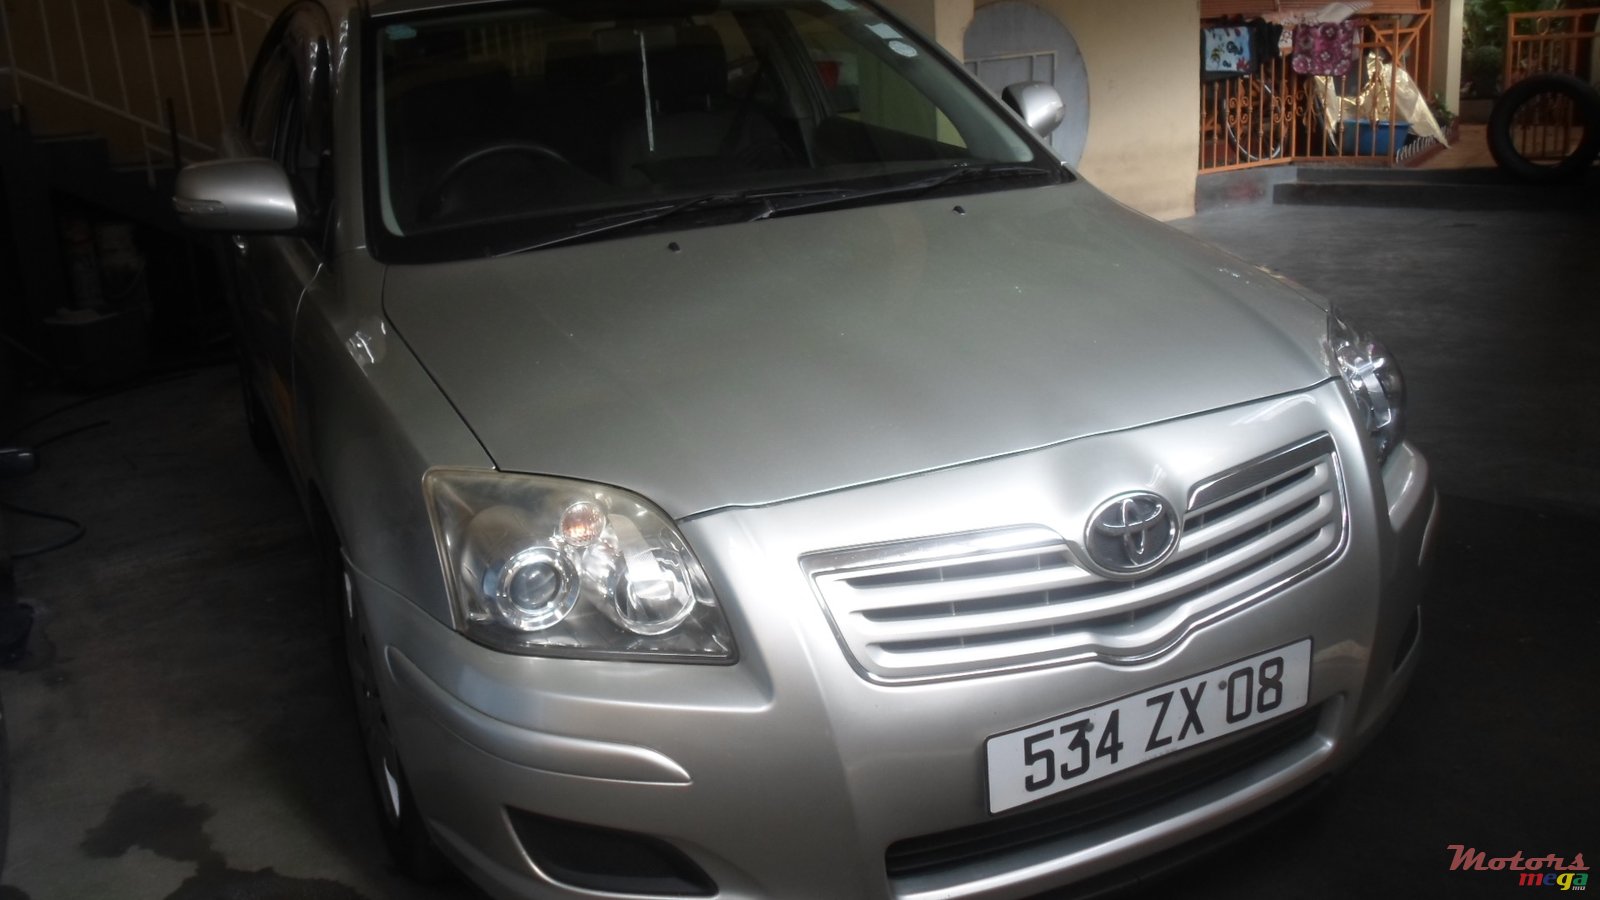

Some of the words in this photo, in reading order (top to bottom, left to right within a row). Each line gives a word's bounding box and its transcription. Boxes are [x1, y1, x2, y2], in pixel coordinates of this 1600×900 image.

[1024, 709, 1123, 792] 534
[1145, 681, 1207, 752] ZX
[1226, 656, 1284, 724] 08
